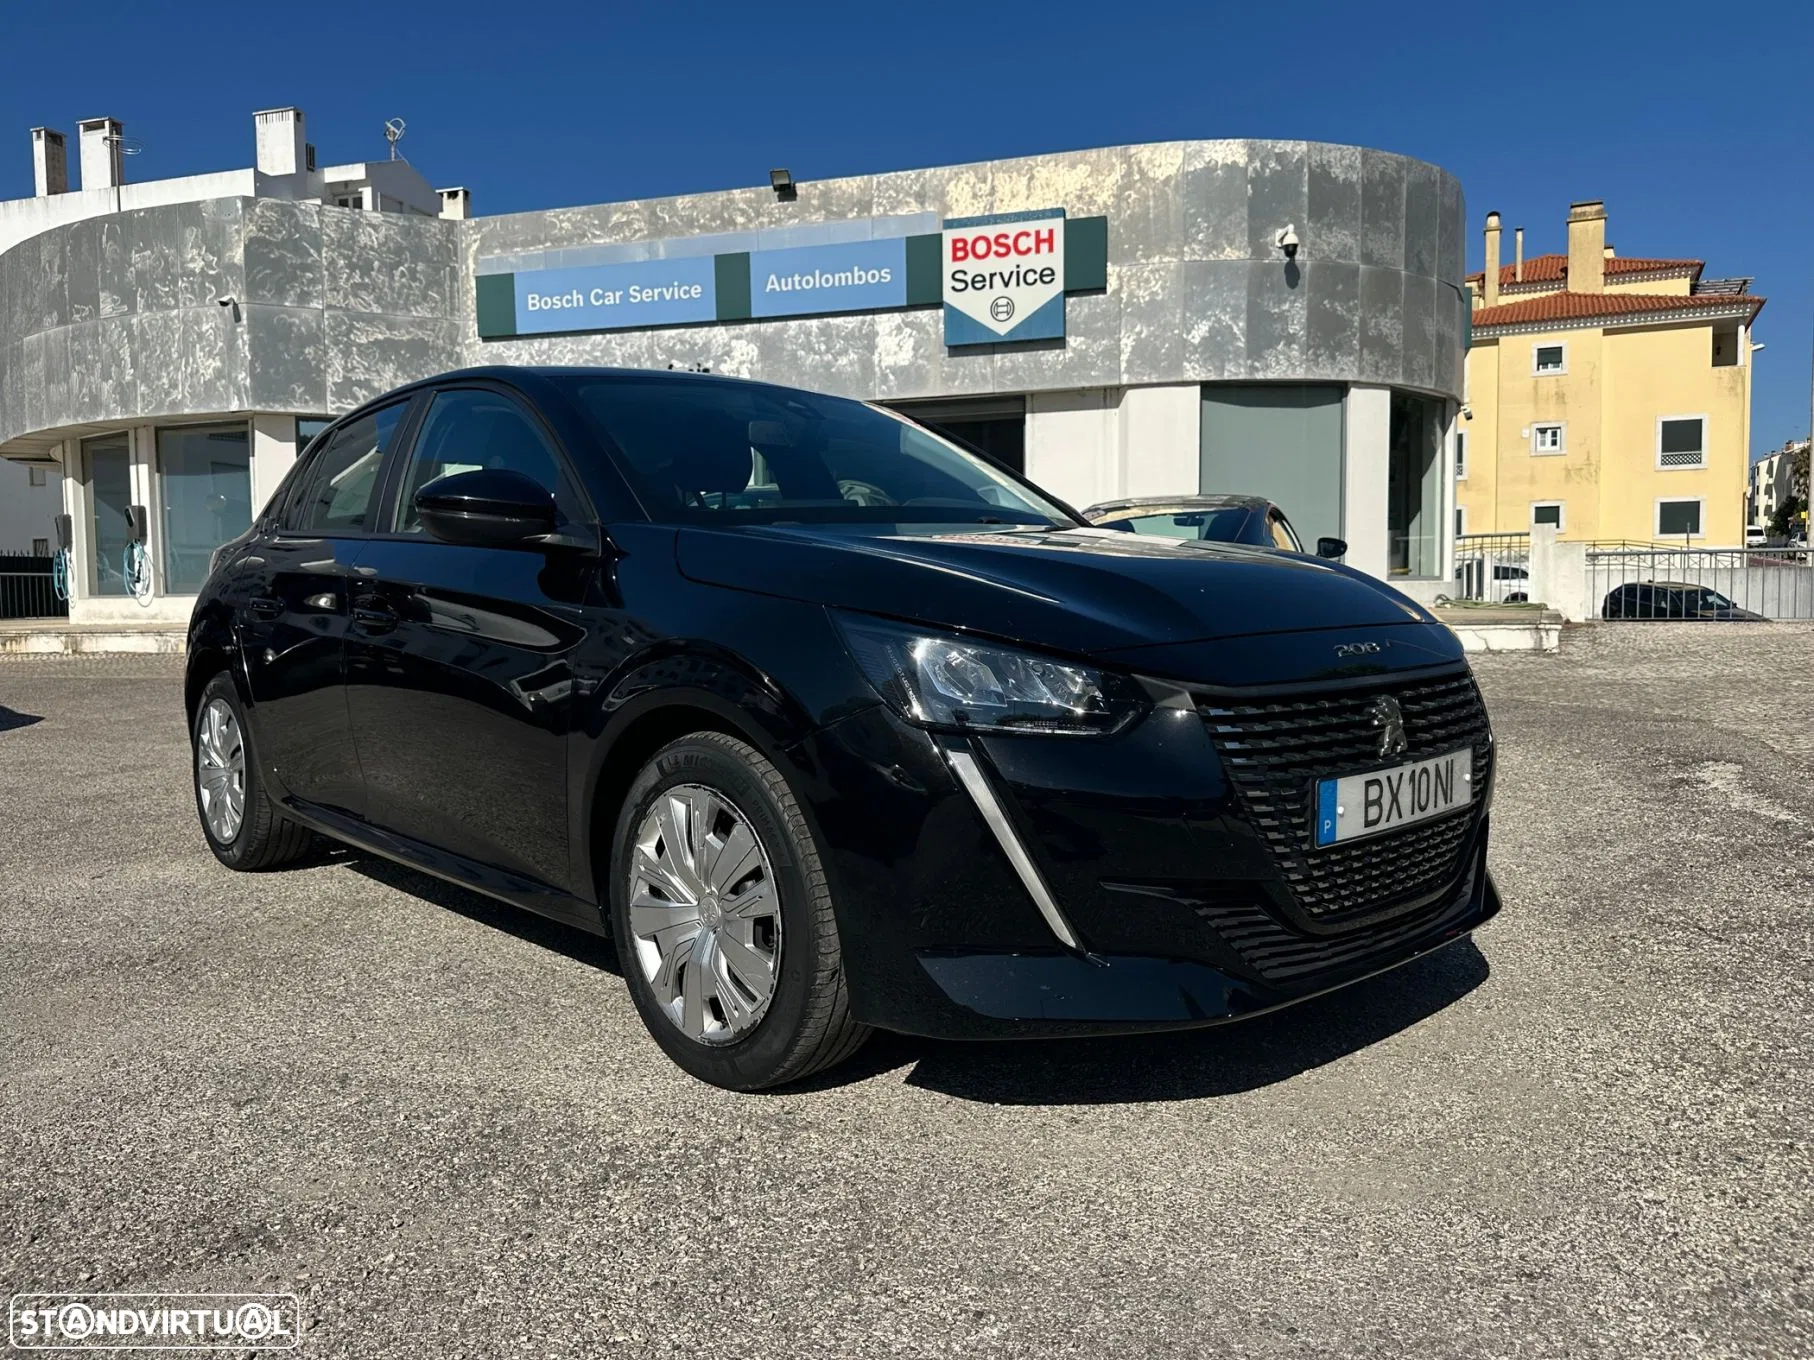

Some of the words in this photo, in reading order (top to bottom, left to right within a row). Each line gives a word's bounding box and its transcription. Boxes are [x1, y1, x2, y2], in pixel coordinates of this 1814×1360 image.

[952, 228, 1054, 262] BOSCH
[765, 266, 892, 292] Autolombos
[951, 264, 1056, 293] Service
[528, 290, 584, 311] Bosch
[590, 288, 623, 306] Car
[629, 281, 702, 303] Service
[1324, 819, 1332, 834] P
